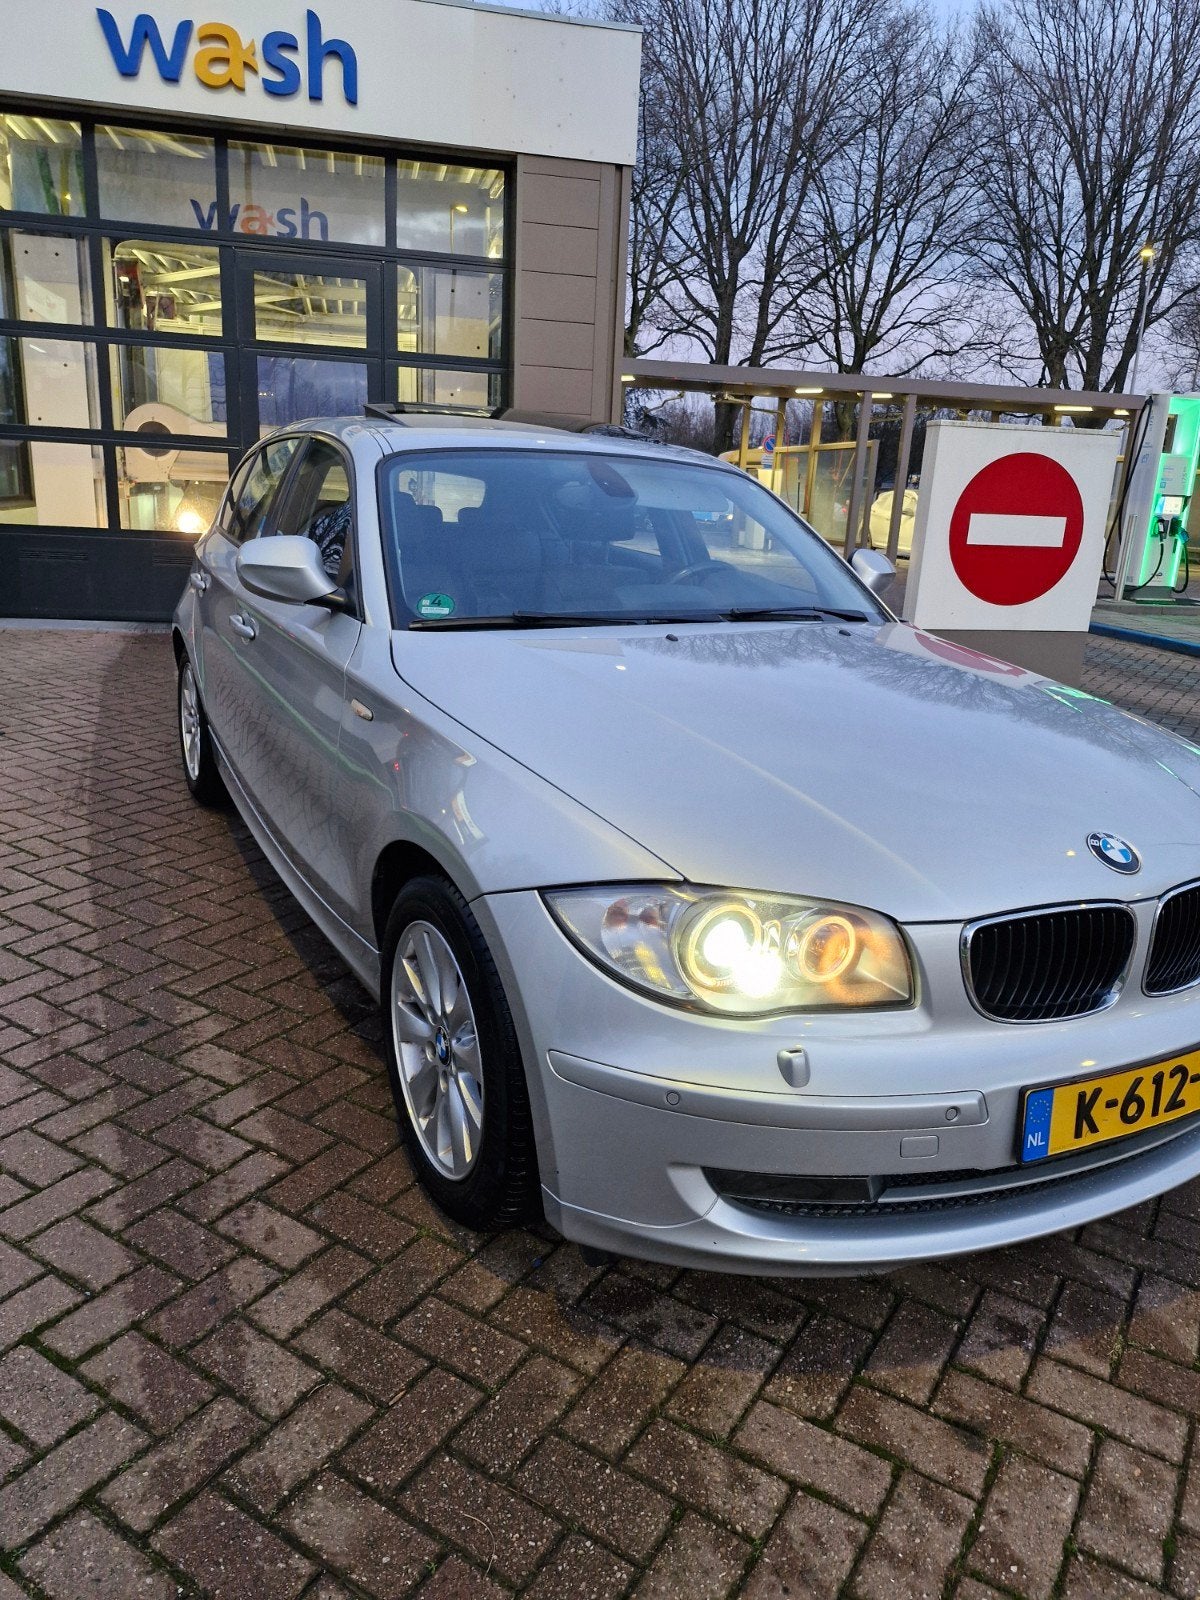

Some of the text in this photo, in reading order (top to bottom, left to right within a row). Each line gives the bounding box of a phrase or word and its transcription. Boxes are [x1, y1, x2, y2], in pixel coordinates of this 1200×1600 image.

[96, 8, 357, 105] wash
[190, 197, 328, 241] wash
[431, 595, 442, 607] 4
[1027, 1132, 1045, 1148] NL
